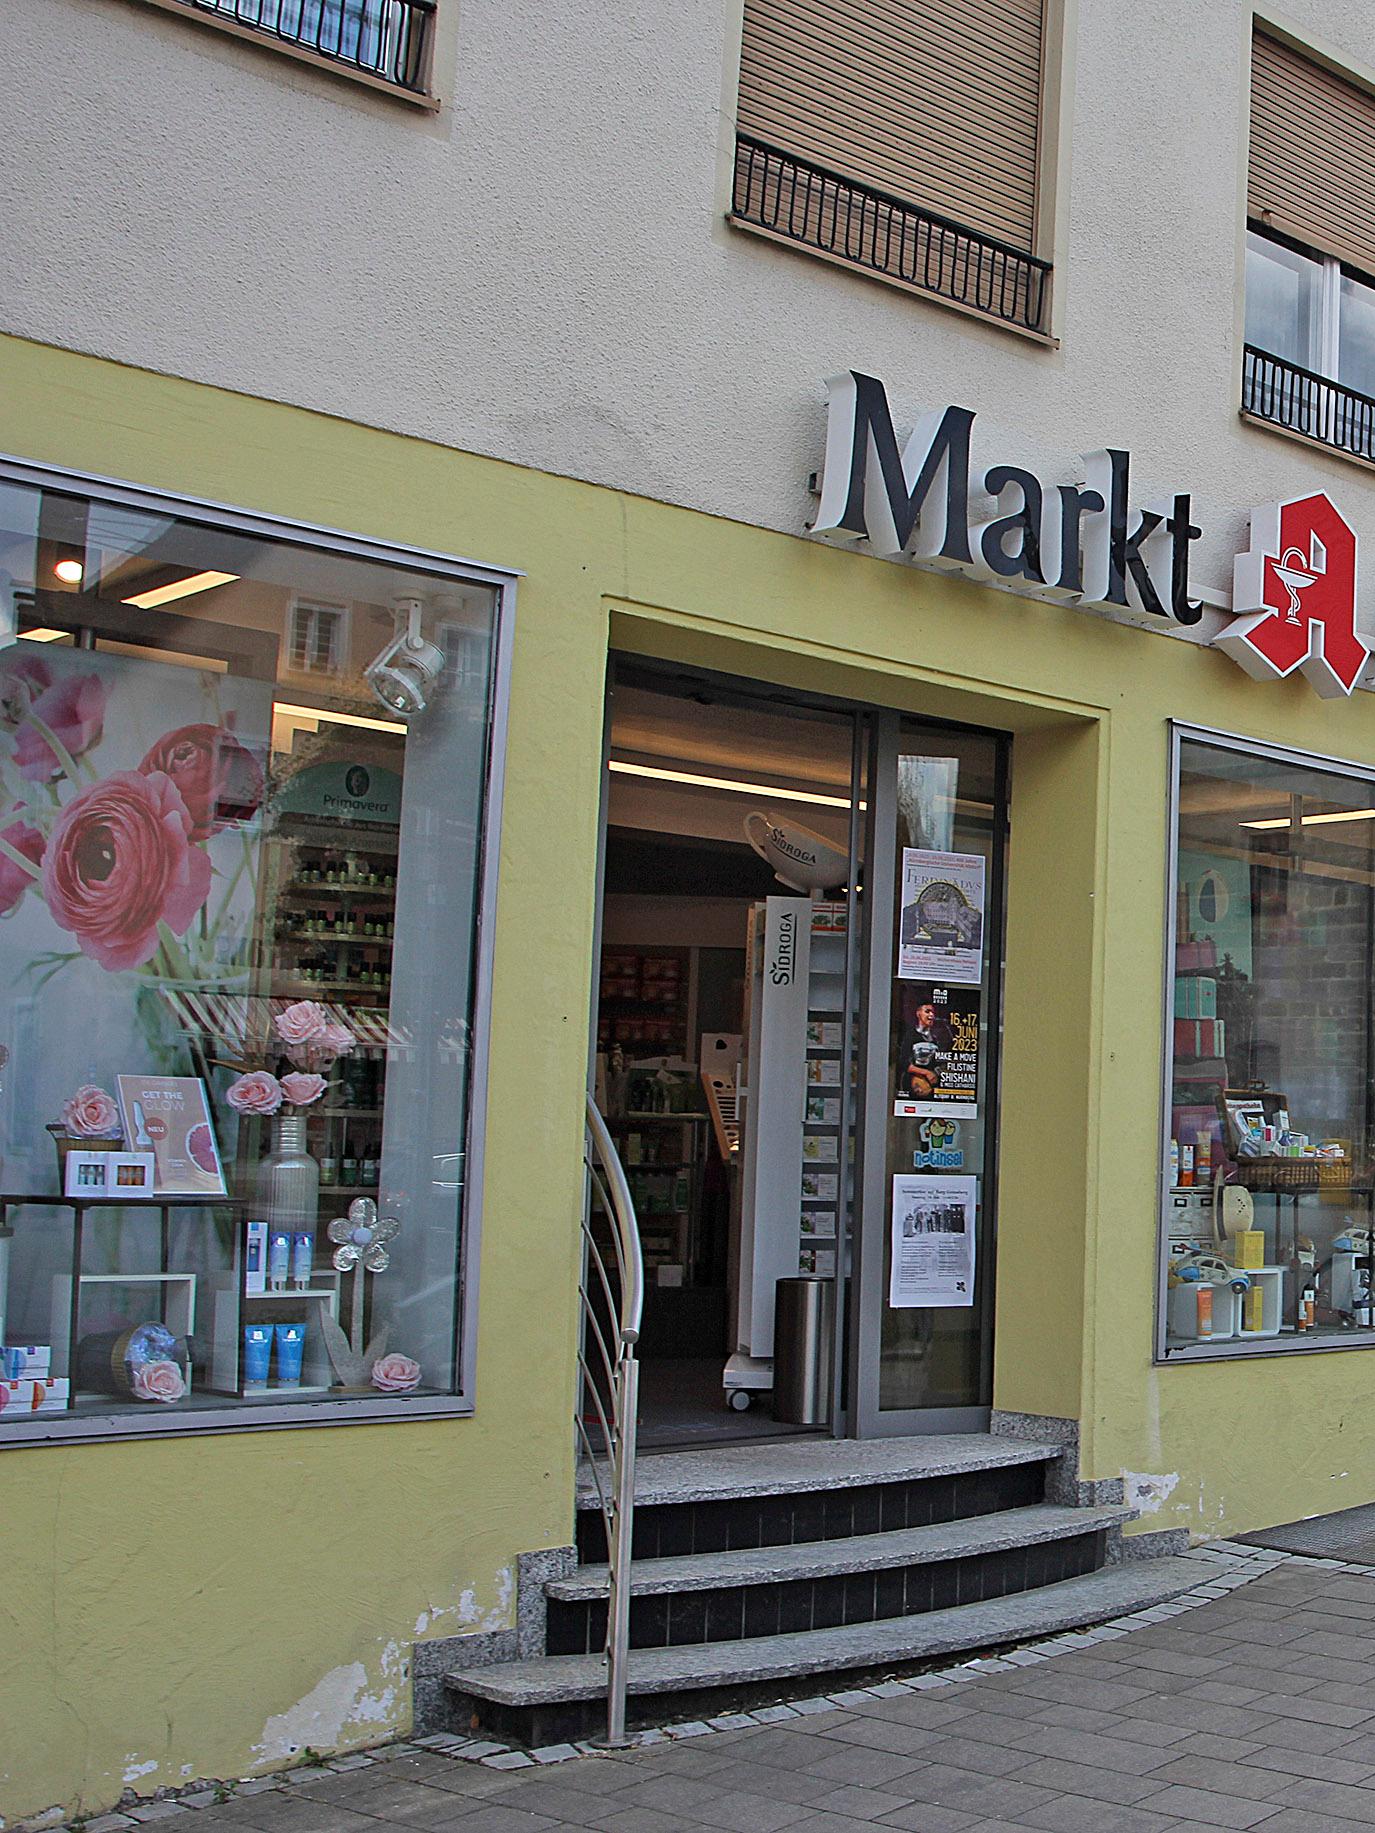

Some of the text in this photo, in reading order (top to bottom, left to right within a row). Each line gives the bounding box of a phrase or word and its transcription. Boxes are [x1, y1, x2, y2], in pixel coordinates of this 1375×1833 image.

[838, 369, 1203, 626] Markt
[323, 794, 389, 813] Primavera
[771, 828, 817, 864] SIDROGA
[772, 912, 793, 986] SIDROGA
[956, 1026, 978, 1039] JUNI
[952, 1039, 978, 1051] 2023
[935, 1051, 952, 1061] MAKE
[959, 1053, 977, 1062] MOVE
[947, 1062, 976, 1072] FILISTINE
[940, 1071, 976, 1084] SHISHANI
[142, 1090, 183, 1100] GET THE
[144, 1100, 185, 1111] GLOW
[915, 1151, 963, 1166] notinsel
